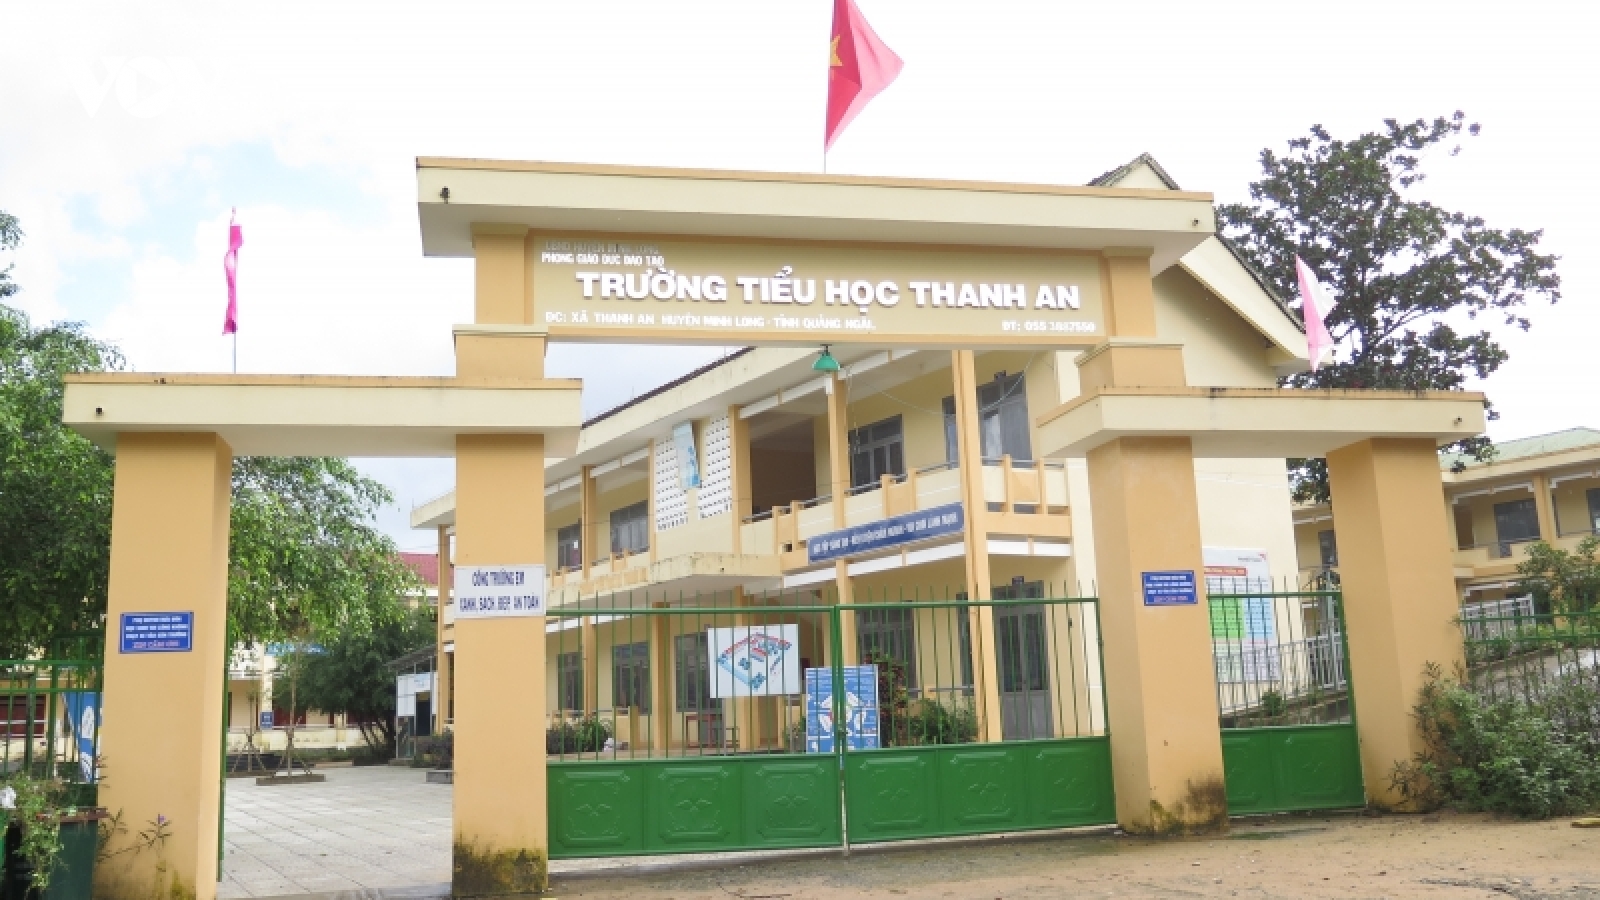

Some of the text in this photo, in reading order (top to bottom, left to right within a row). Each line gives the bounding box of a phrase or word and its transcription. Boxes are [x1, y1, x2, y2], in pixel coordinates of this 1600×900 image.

[576, 265, 1080, 314] TRƯỜNG TIỂU HỌC THANH AN
[594, 313, 633, 325] THANH
[637, 313, 655, 325] AN
[703, 315, 733, 327] MINH
